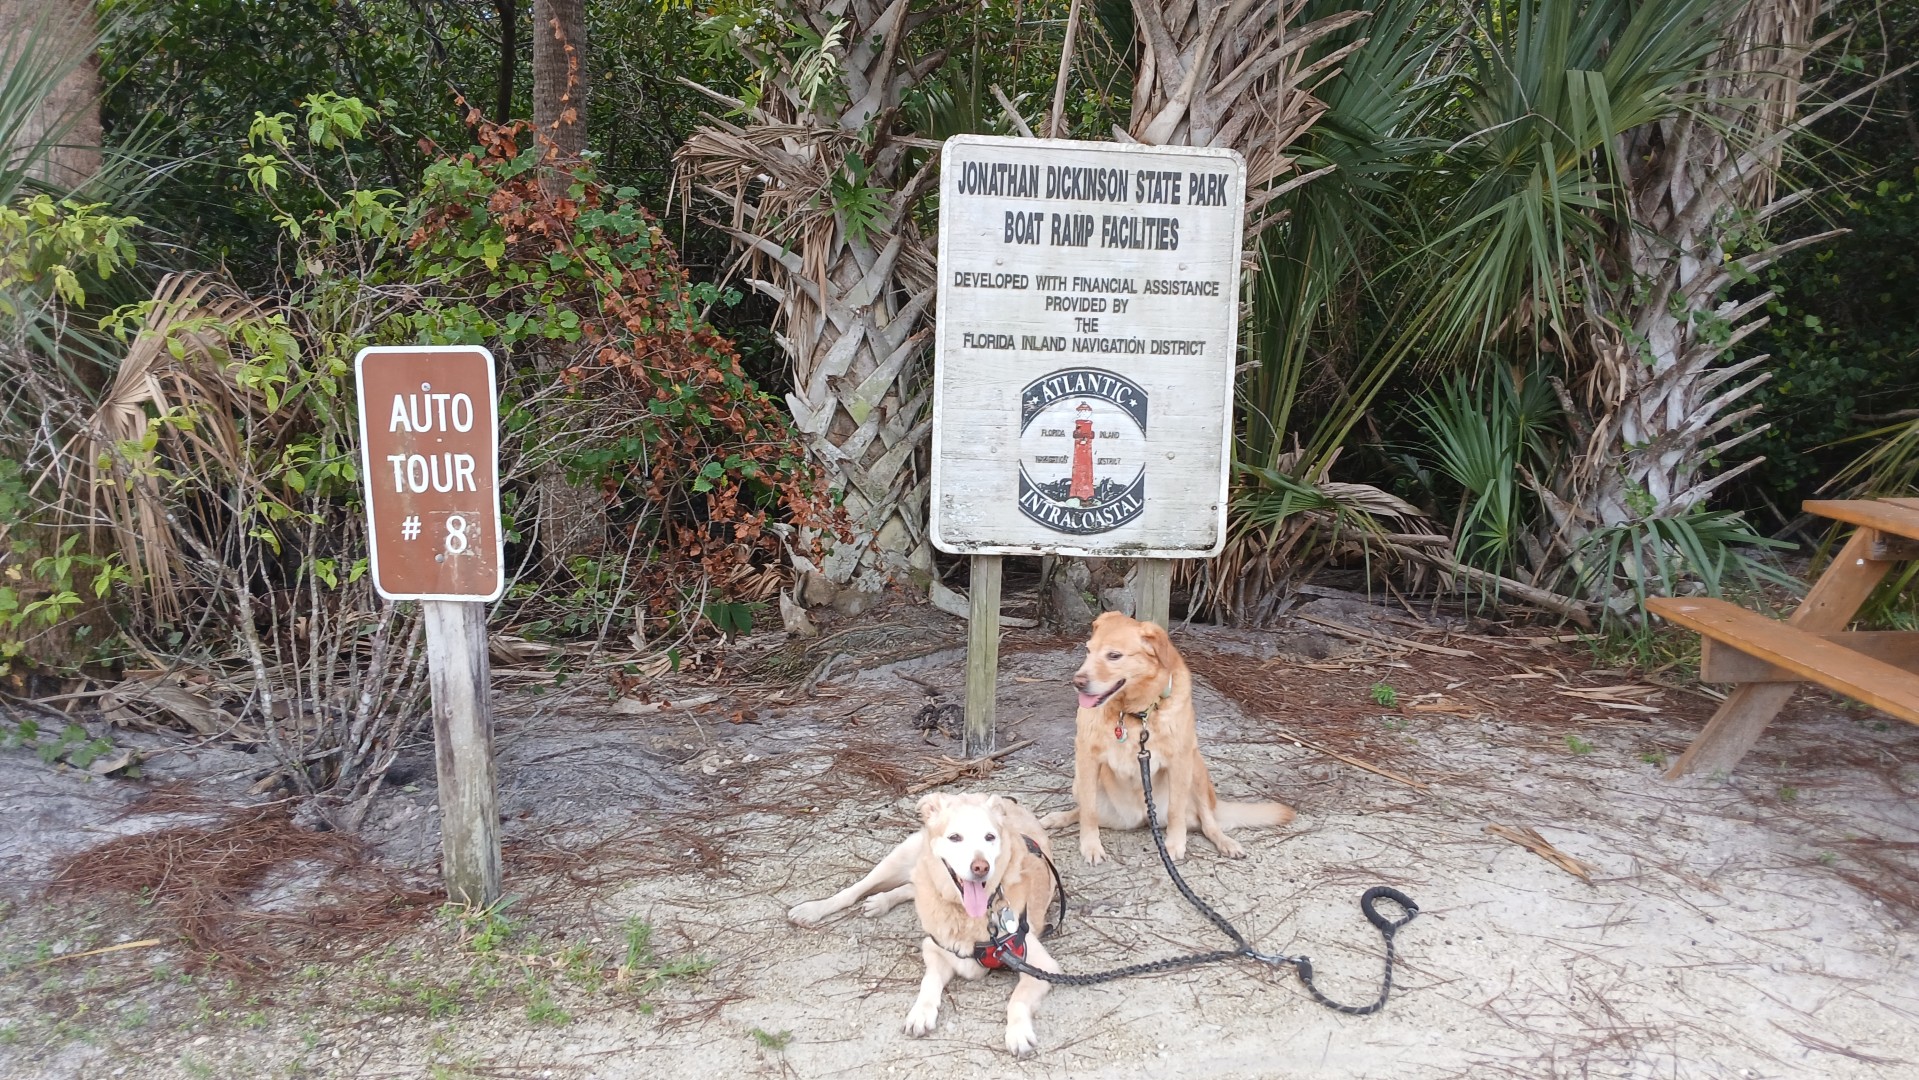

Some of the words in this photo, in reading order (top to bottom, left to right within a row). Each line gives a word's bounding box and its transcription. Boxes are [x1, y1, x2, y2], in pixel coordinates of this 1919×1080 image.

[958, 162, 1039, 198] JONATHAN
[1046, 166, 1129, 202] DICKINSON
[1136, 170, 1182, 204] STATE
[1187, 173, 1228, 206] PARK
[1004, 211, 1044, 245] BOAT
[1051, 213, 1094, 247] RAMP
[1101, 215, 1179, 250] FACILITIES
[955, 272, 1028, 289] DEVELOPED
[1036, 275, 1067, 291] WITH
[1072, 277, 1137, 294] FINANCIAL
[1144, 280, 1219, 296] ASSISTANCE
[1045, 296, 1106, 313] PROVIDED
[1113, 299, 1129, 313] BY
[963, 333, 1015, 350] FLORIDA
[1022, 335, 1067, 351] INLAND
[1072, 337, 1145, 354] NAVIGATION
[1151, 340, 1206, 355] DISTRICT
[1075, 318, 1098, 333] THE
[1041, 374, 1132, 404] ATLANTIC
[389, 393, 473, 432] AUTO
[387, 453, 476, 493] TOUR
[1020, 489, 1142, 529] INTRACOASTAL
[401, 516, 421, 540] #
[445, 515, 467, 554] 8
